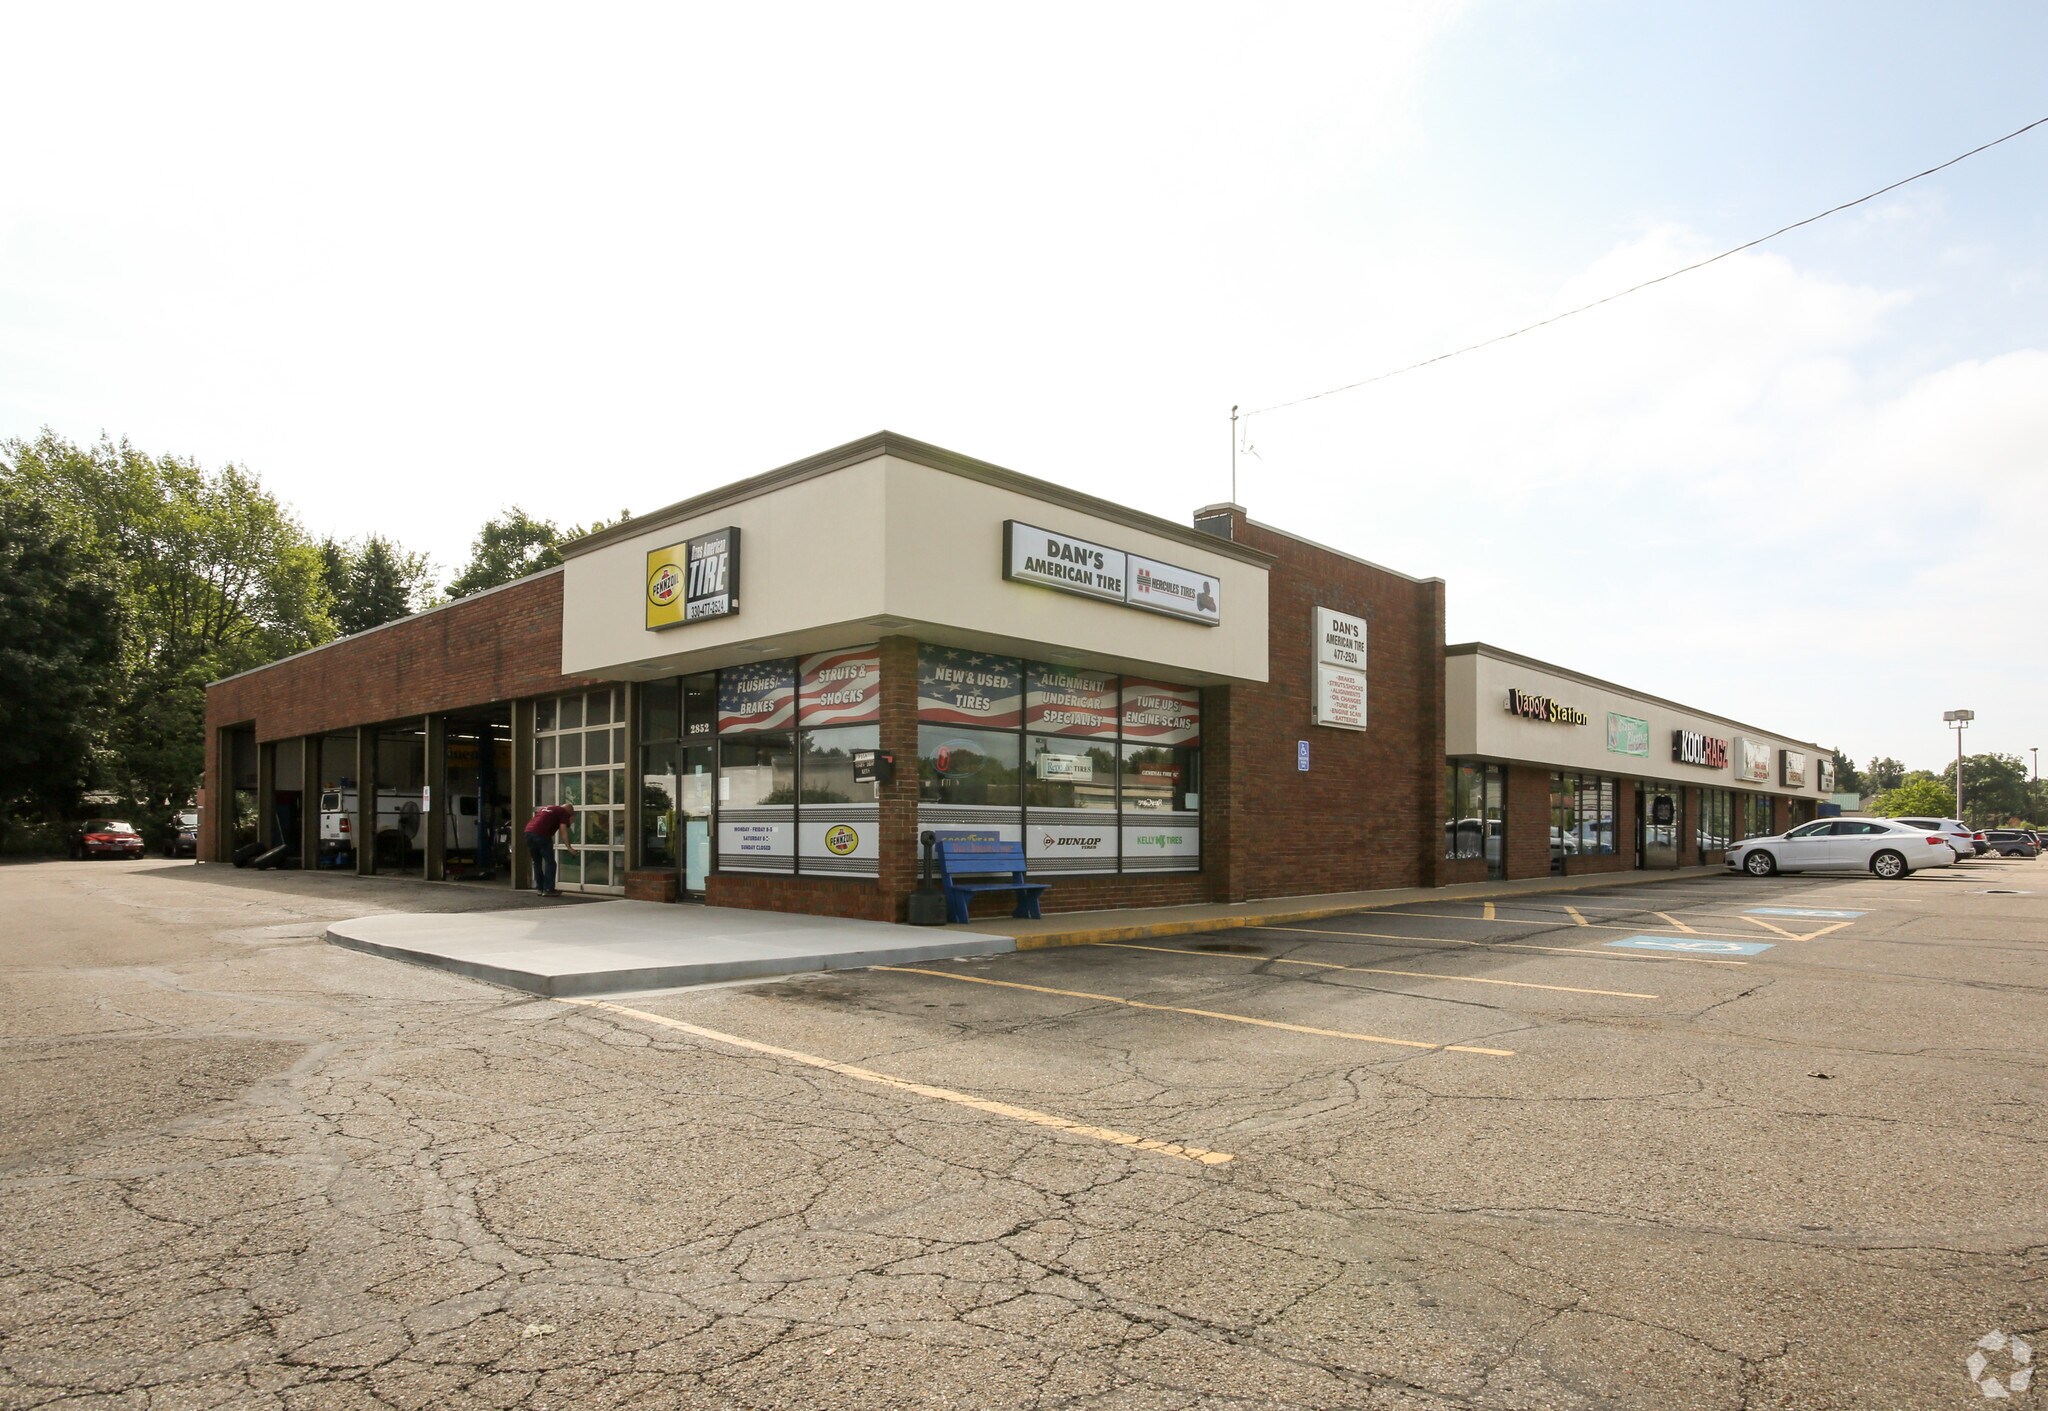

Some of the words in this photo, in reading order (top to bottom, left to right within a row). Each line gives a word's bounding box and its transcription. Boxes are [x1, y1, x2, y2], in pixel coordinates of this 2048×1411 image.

[1047, 539, 1104, 570] DAN'S
[688, 552, 728, 598] TIRE
[1024, 557, 1093, 585] AMERICAN
[1097, 574, 1122, 592] TIRE
[652, 572, 679, 597] PENNZOIL
[1151, 577, 1180, 595] HERCULES
[1180, 586, 1196, 599] TIRES
[1332, 619, 1359, 638] DAN'S
[1326, 633, 1354, 650] AMERICAN
[1354, 640, 1365, 653] TIRE
[1333, 649, 1358, 664] 477-2524
[818, 666, 857, 684] STRUTS
[857, 664, 867, 678] &
[935, 667, 965, 685] NEW
[966, 671, 975, 685] &
[977, 674, 1009, 689] USED
[1338, 675, 1355, 684] BRAKES
[1041, 673, 1105, 693] ALIGNMENT/
[820, 689, 864, 706] SHOCKS
[955, 694, 991, 711] TIRES
[1137, 695, 1161, 709] TUNE
[1340, 696, 1362, 704] CHANGES
[740, 700, 775, 716] BRAKES
[1350, 710, 1362, 718] SCAN
[1549, 698, 1588, 726] Station
[1043, 709, 1103, 727] SPECIALIST
[1125, 711, 1160, 726] ENGINE
[1161, 715, 1192, 730] SCANS
[1335, 715, 1358, 724] BATTERIES
[690, 723, 710, 734] 2852
[1073, 765, 1092, 773] TIRES
[830, 833, 854, 846] PENNZOIL
[1057, 837, 1101, 846] DUNLOP
[1137, 836, 1155, 845] KELLY
[1166, 836, 1183, 844] TIRES
